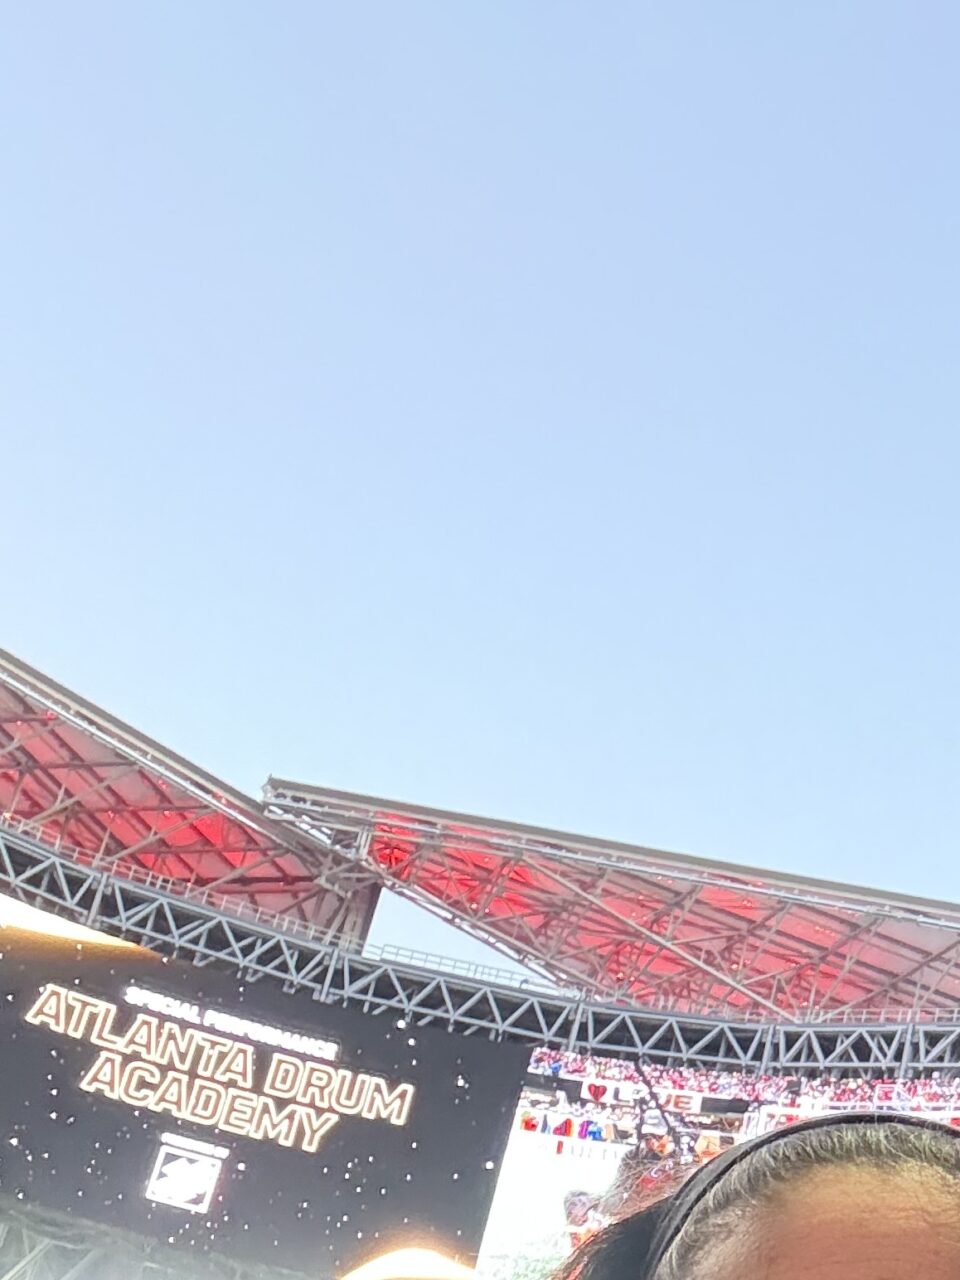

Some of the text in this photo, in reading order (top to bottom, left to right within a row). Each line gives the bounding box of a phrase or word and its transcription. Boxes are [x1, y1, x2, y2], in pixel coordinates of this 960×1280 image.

[25, 984, 414, 1125] ATLANTA DRUM
[81, 1050, 338, 1153] ACADEMY
